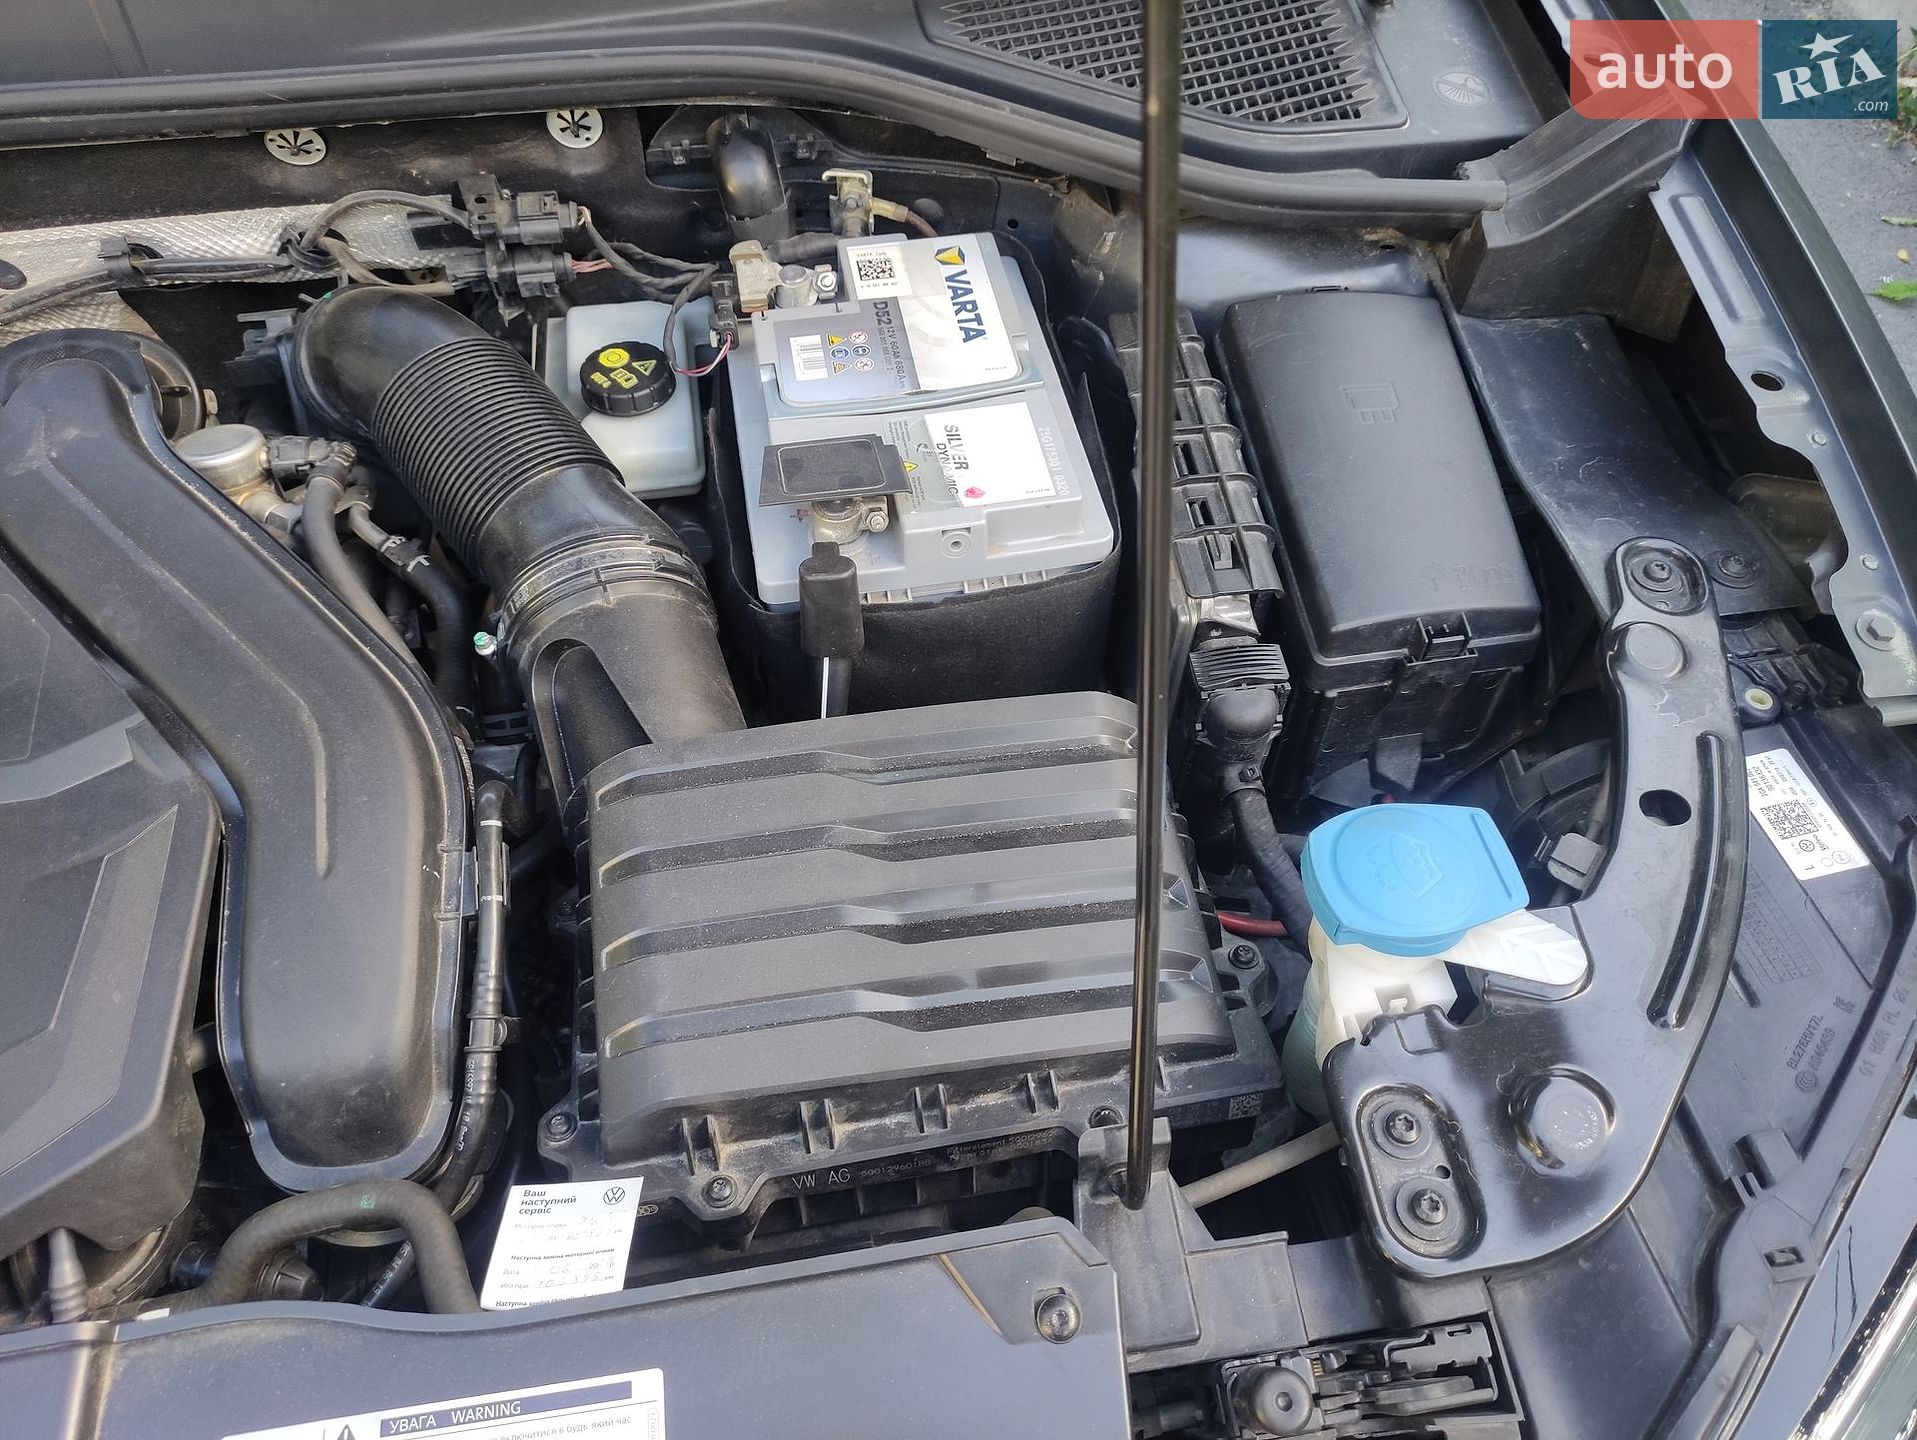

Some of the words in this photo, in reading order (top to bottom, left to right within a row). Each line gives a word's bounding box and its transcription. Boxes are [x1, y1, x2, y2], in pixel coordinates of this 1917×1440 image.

[873, 301, 893, 327] D52
[944, 269, 985, 344] VARTA
[943, 425, 970, 471] SILVER
[936, 442, 959, 495] DYNAMIC
[792, 1173, 817, 1190] VW
[827, 1166, 851, 1186] AG
[520, 1195, 577, 1208] наступний
[523, 1188, 546, 1198] Ваш
[519, 1206, 552, 1216] сервіс
[389, 1414, 437, 1435] УВАГА
[451, 1400, 522, 1426] WARNING
[616, 1416, 632, 1425] час
